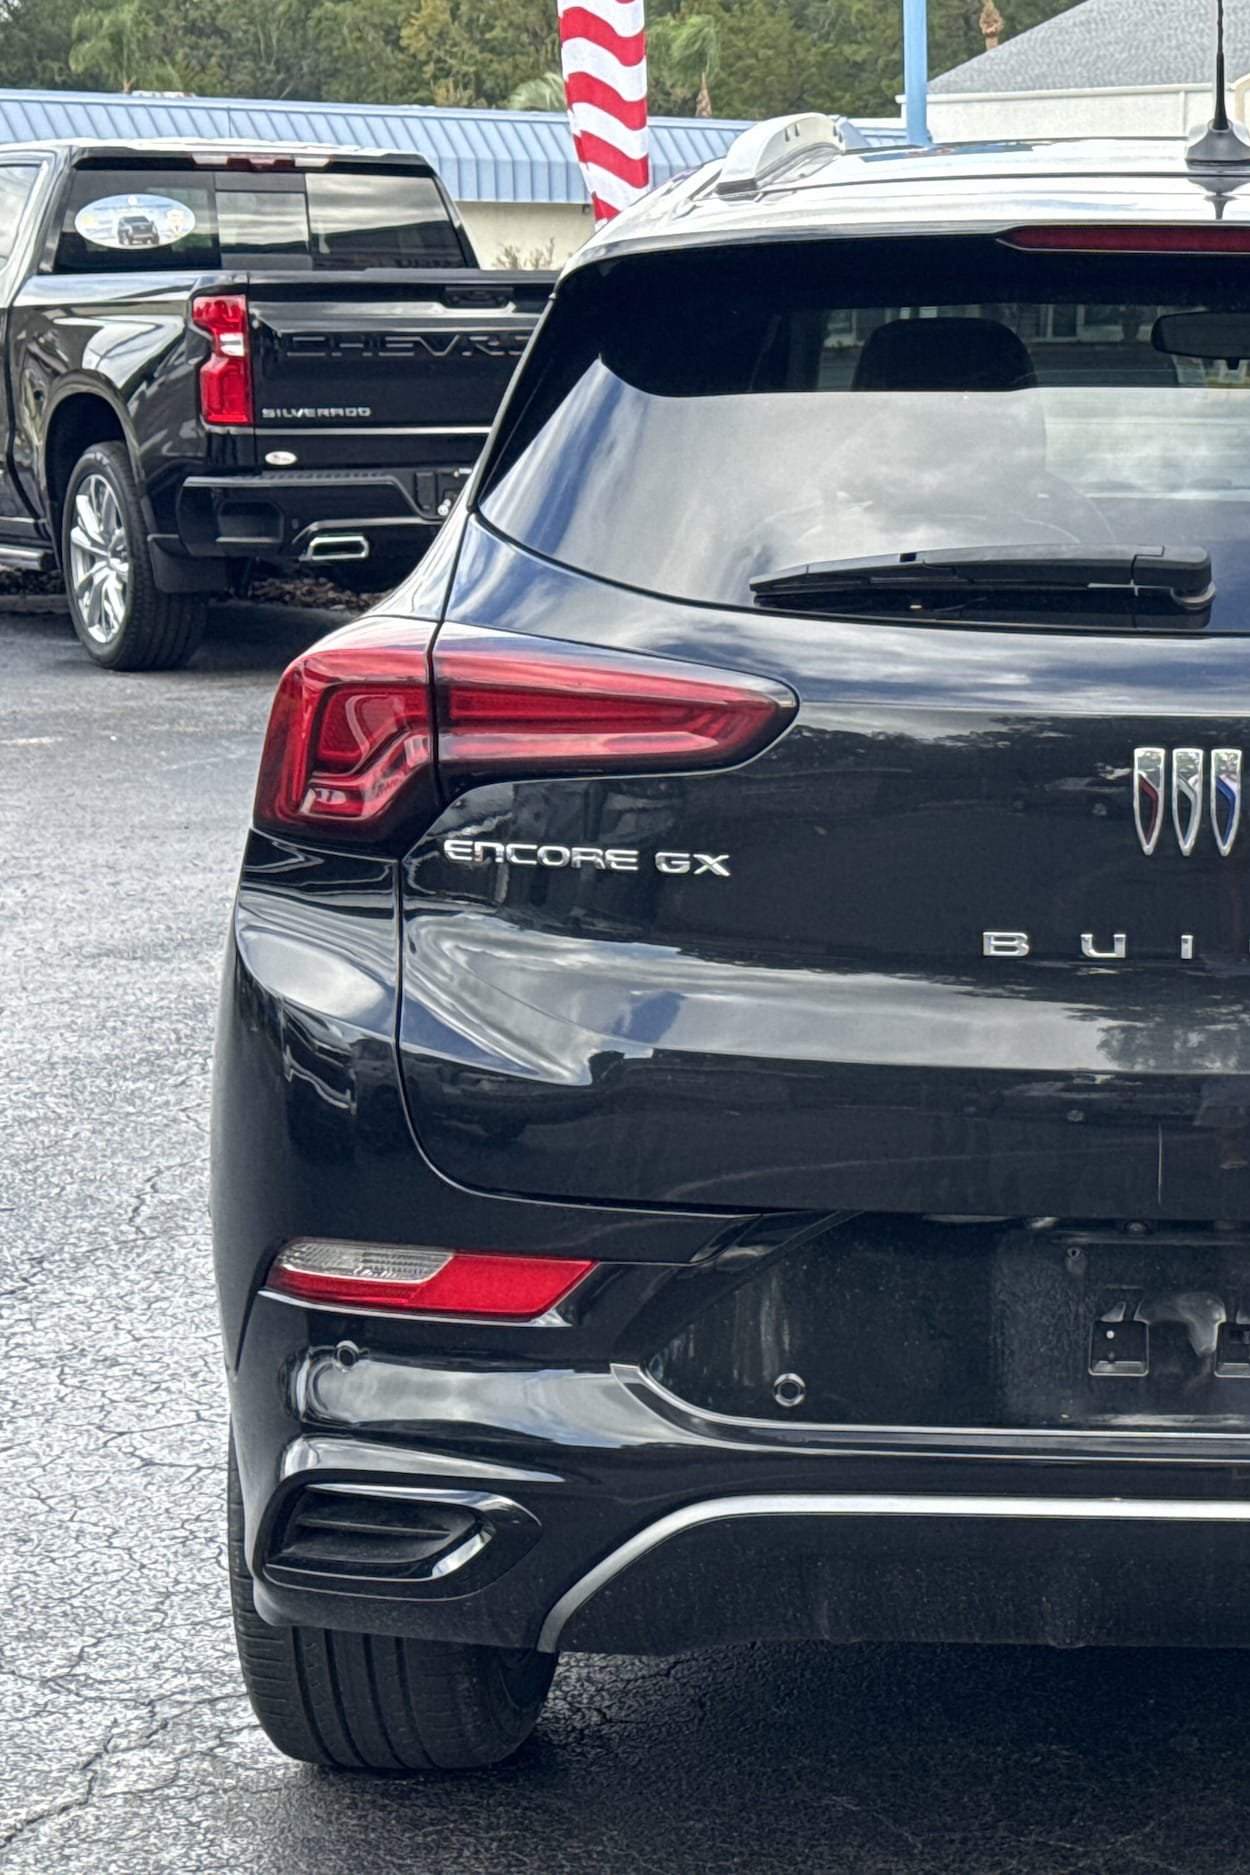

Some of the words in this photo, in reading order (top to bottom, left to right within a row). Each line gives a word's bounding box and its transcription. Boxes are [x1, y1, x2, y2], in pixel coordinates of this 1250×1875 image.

[262, 407, 371, 418] SILVERADO
[444, 839, 639, 871] ENCORE
[655, 851, 731, 876] GX
